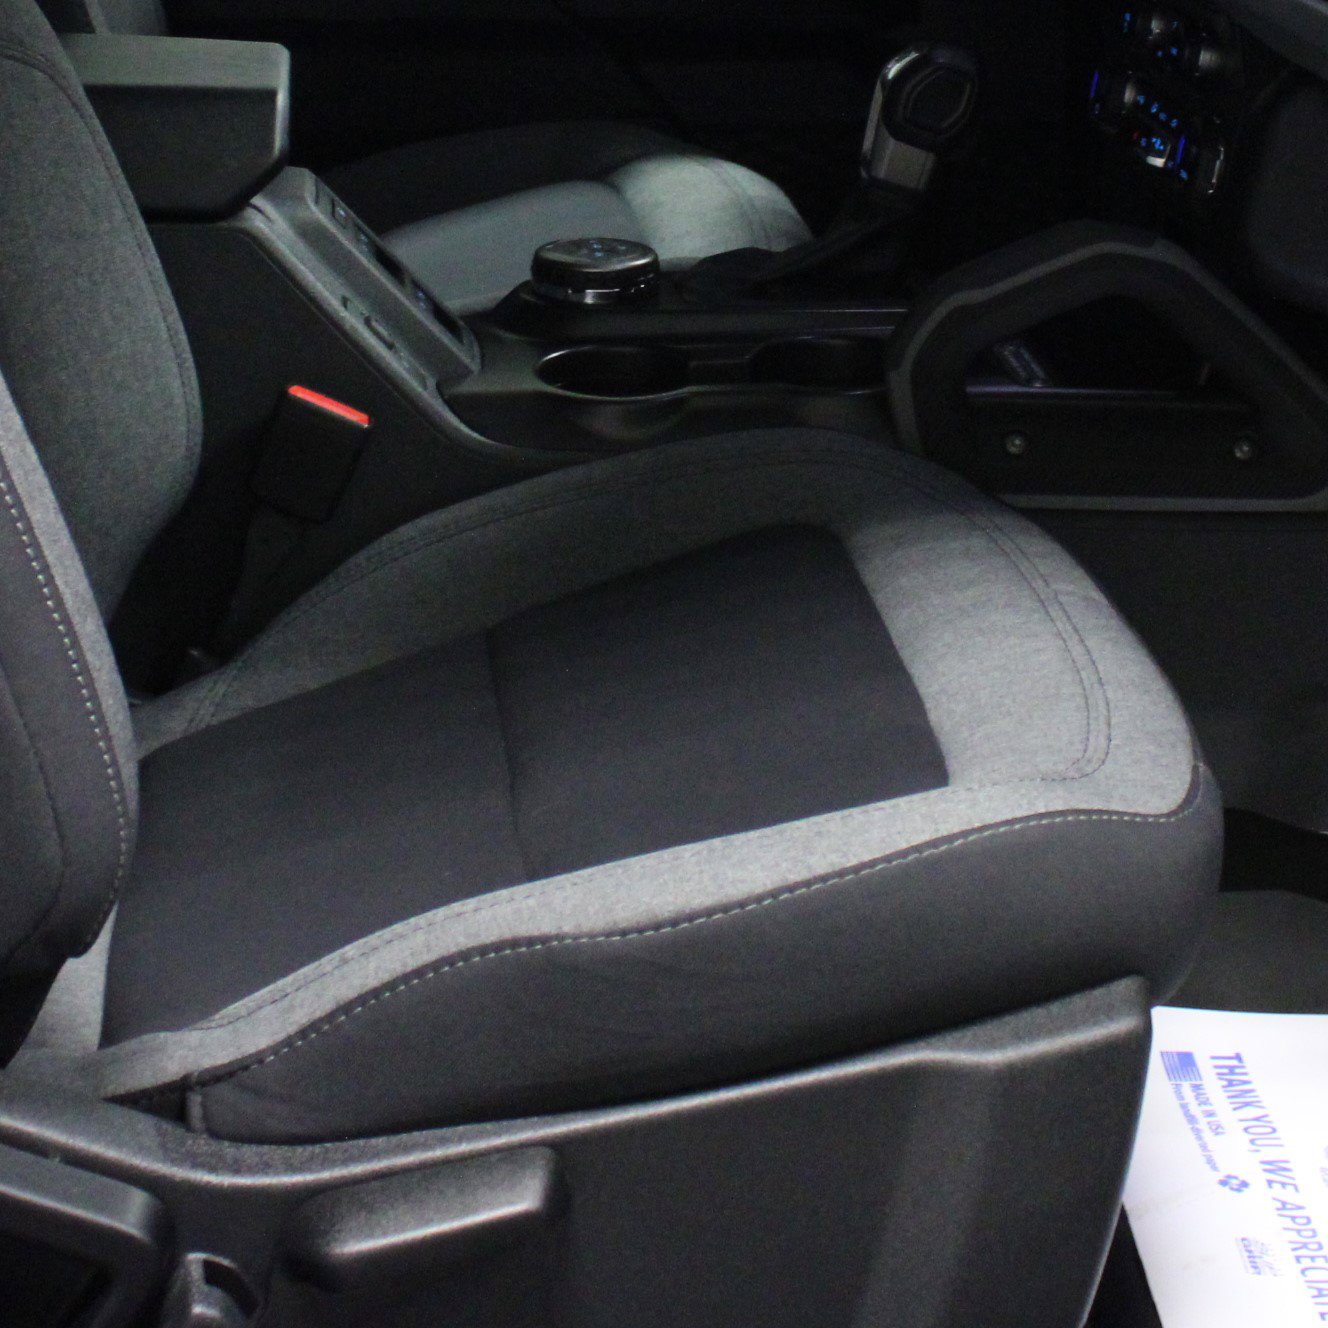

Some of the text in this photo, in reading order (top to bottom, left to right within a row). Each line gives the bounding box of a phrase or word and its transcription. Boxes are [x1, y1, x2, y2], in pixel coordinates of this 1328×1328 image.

[1209, 1052, 1267, 1112] THANK
[1237, 1113, 1285, 1153] YOU,
[1258, 1159, 1300, 1194] WE
